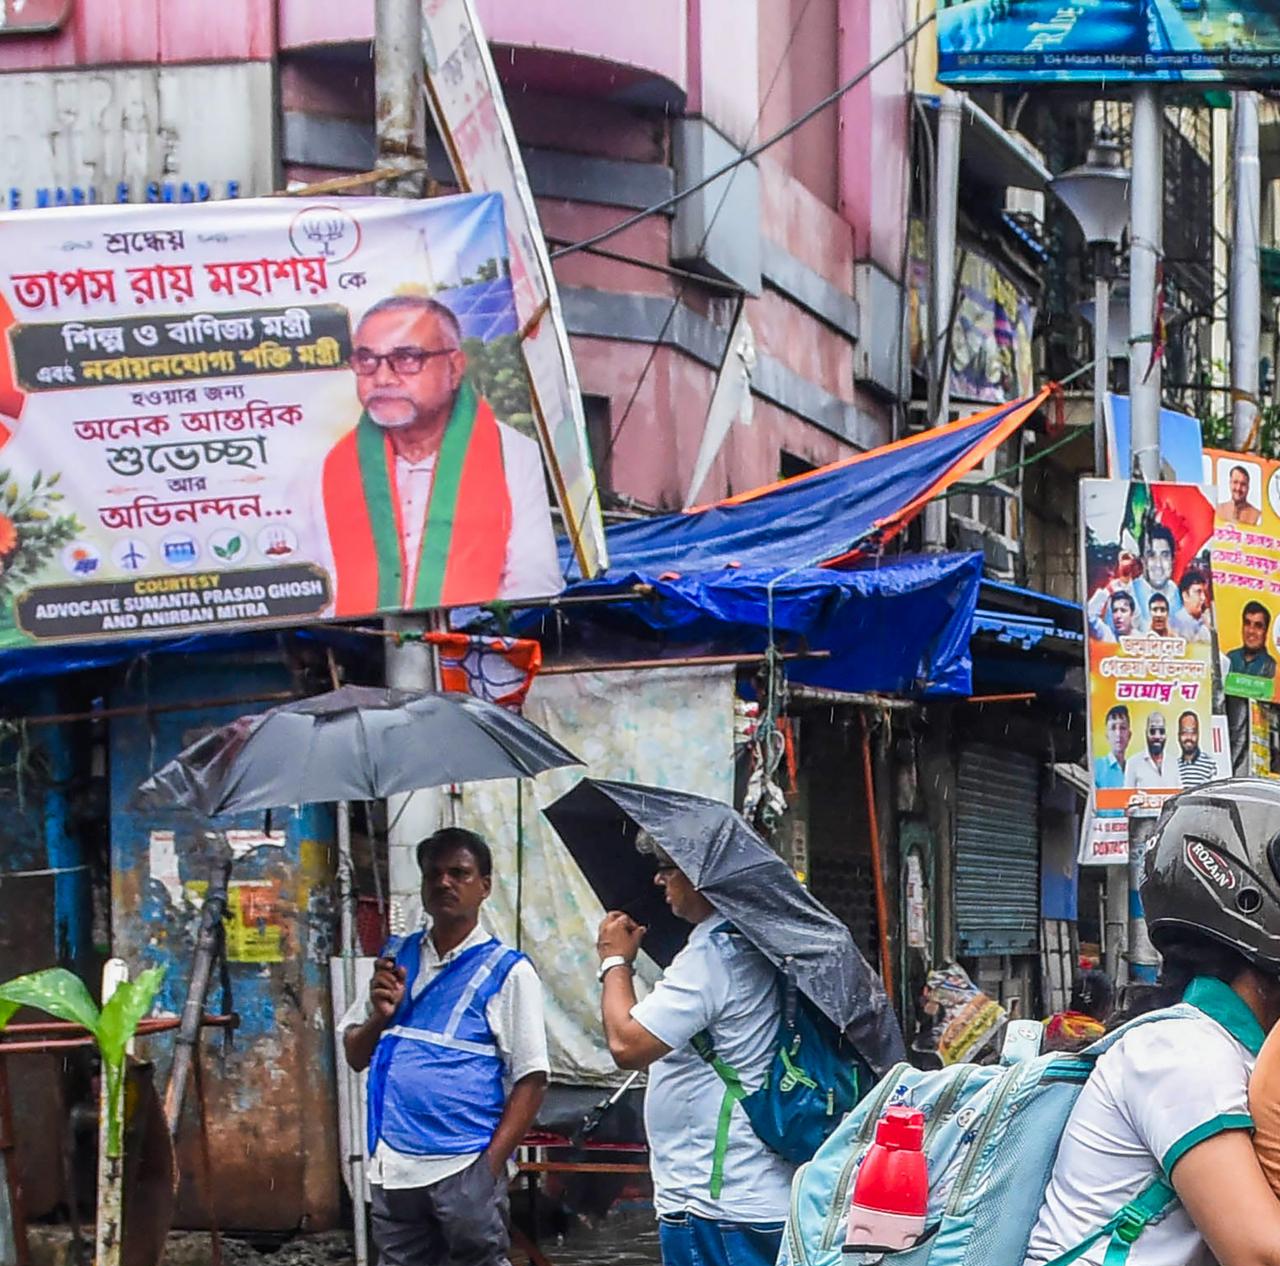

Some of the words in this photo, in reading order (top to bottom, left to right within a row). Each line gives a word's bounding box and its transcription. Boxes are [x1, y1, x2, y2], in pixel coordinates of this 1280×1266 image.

[10, 266, 117, 309] তাপস
[126, 264, 195, 305] রায়
[203, 255, 329, 297] মহাশয়
[338, 270, 368, 290] কে
[61, 320, 125, 353] শিল্প
[132, 324, 160, 347] ও
[165, 312, 255, 345] বাণিজ্য
[262, 307, 311, 340] মন্ত্রী
[36, 360, 76, 384] এবং
[240, 341, 292, 370] শক্তি
[296, 336, 340, 366] মন্ত্রী
[131, 387, 197, 407] হওয়ার
[204, 385, 245, 402] জন্য
[73, 411, 170, 443] অনেক
[181, 399, 305, 434] আন্তরিক
[106, 435, 268, 477] শুভেচ্ছা
[167, 476, 207, 494] আর
[35, 600, 121, 620] ADVOCATE
[124, 593, 200, 613] SUMANTA
[203, 586, 266, 607] PRASAD
[268, 580, 323, 600] GHOSH
[134, 574, 220, 595] COURTESY
[102, 613, 138, 630] AND
[142, 607, 214, 628] ANIRBAN
[218, 602, 269, 622] MITRA
